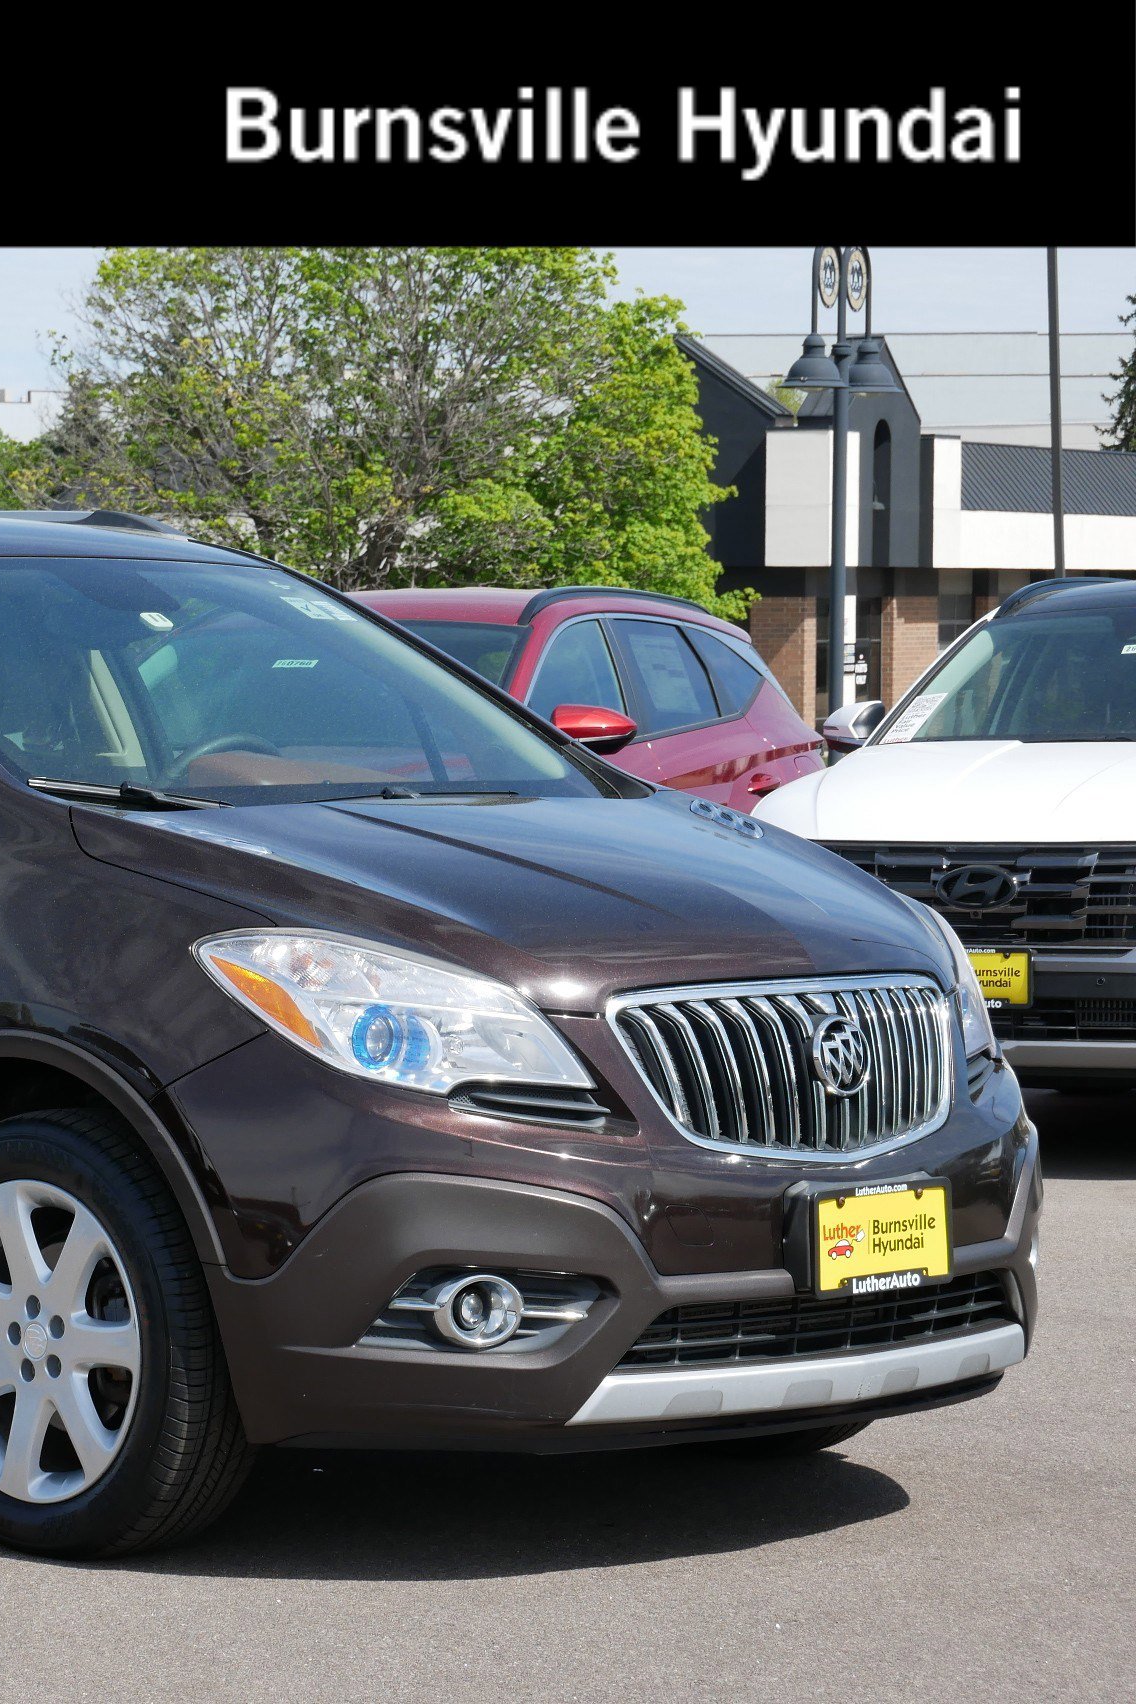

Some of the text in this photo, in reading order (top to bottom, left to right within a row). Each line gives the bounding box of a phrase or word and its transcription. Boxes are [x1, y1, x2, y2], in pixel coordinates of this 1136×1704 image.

[975, 967, 1021, 977] urnsville
[979, 978, 1012, 987] undai
[855, 1183, 907, 1196] LutherAuto.com
[823, 1223, 862, 1241] Luther
[872, 1213, 936, 1235] Burnsville
[872, 1233, 924, 1256] Hyundai
[852, 1271, 921, 1294] LutherAuto
